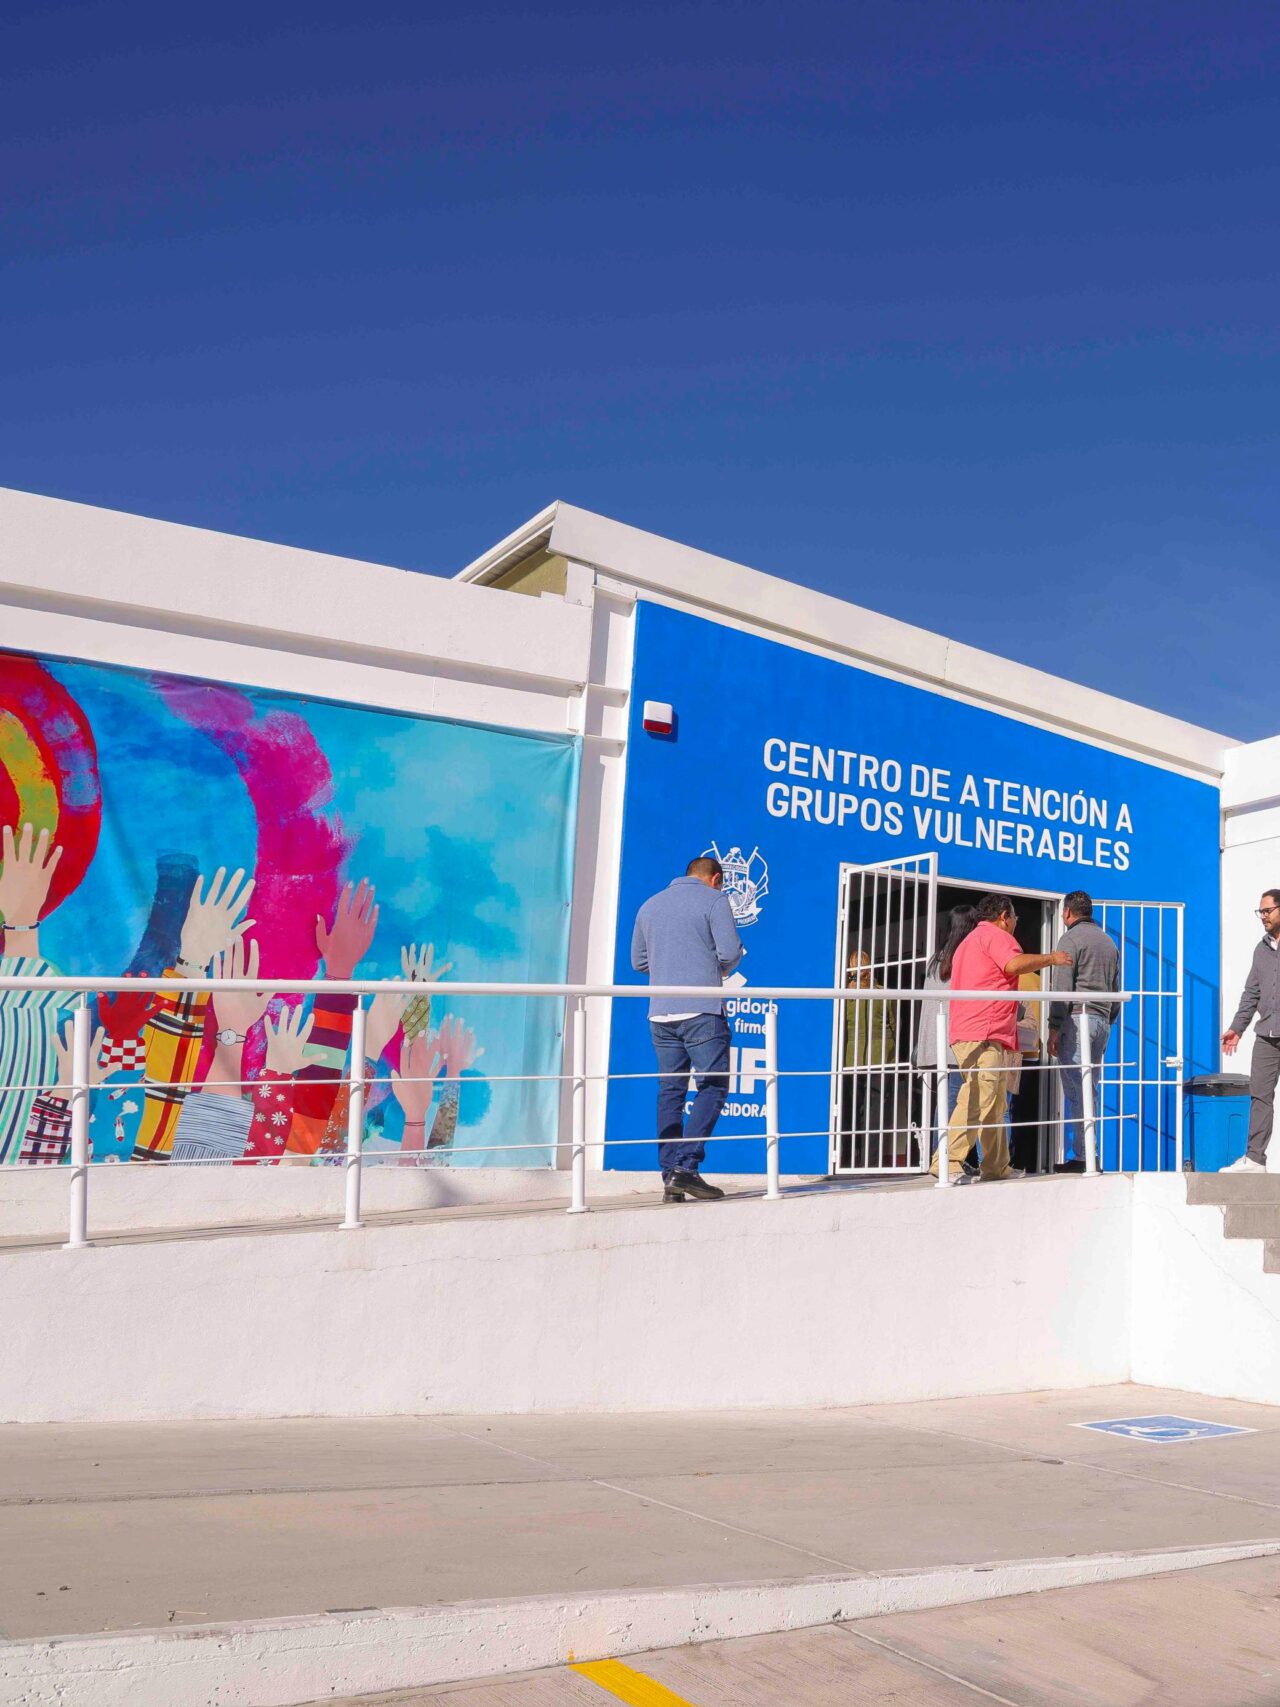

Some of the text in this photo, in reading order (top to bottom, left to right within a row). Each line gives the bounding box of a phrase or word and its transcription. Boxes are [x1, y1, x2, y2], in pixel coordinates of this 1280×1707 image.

[763, 737, 1133, 834] CENTRO DE ATENCIÓN A
[766, 782, 1130, 872] GRUPOS VULNERABLES
[726, 997, 778, 1018] gidora
[682, 1101, 768, 1118] OGIDORA
